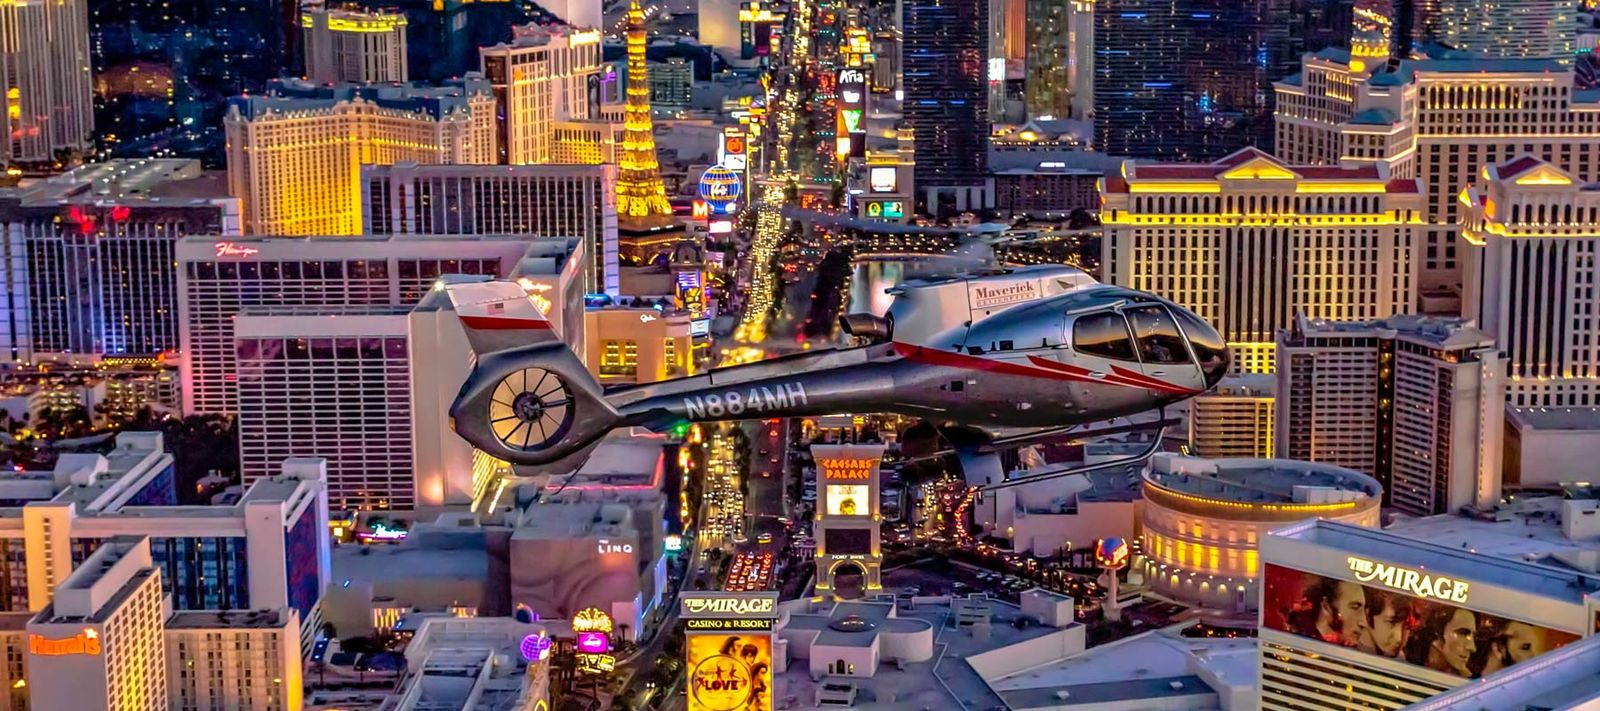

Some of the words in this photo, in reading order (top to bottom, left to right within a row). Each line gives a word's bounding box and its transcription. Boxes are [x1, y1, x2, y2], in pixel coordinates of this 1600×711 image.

[976, 281, 1035, 299] Maverick
[683, 381, 808, 419] N884MH
[823, 459, 872, 469] CAESARS
[826, 469, 870, 479] PALACE
[598, 544, 633, 554] LINQ
[1347, 557, 1374, 573] THE
[1355, 564, 1469, 604] MIRAGE
[685, 599, 705, 607] THE
[690, 599, 773, 614] MIRAGE
[688, 620, 723, 628] CASINO
[724, 620, 732, 628] &
[733, 620, 770, 628] RESORT
[705, 680, 739, 691] LOVE
